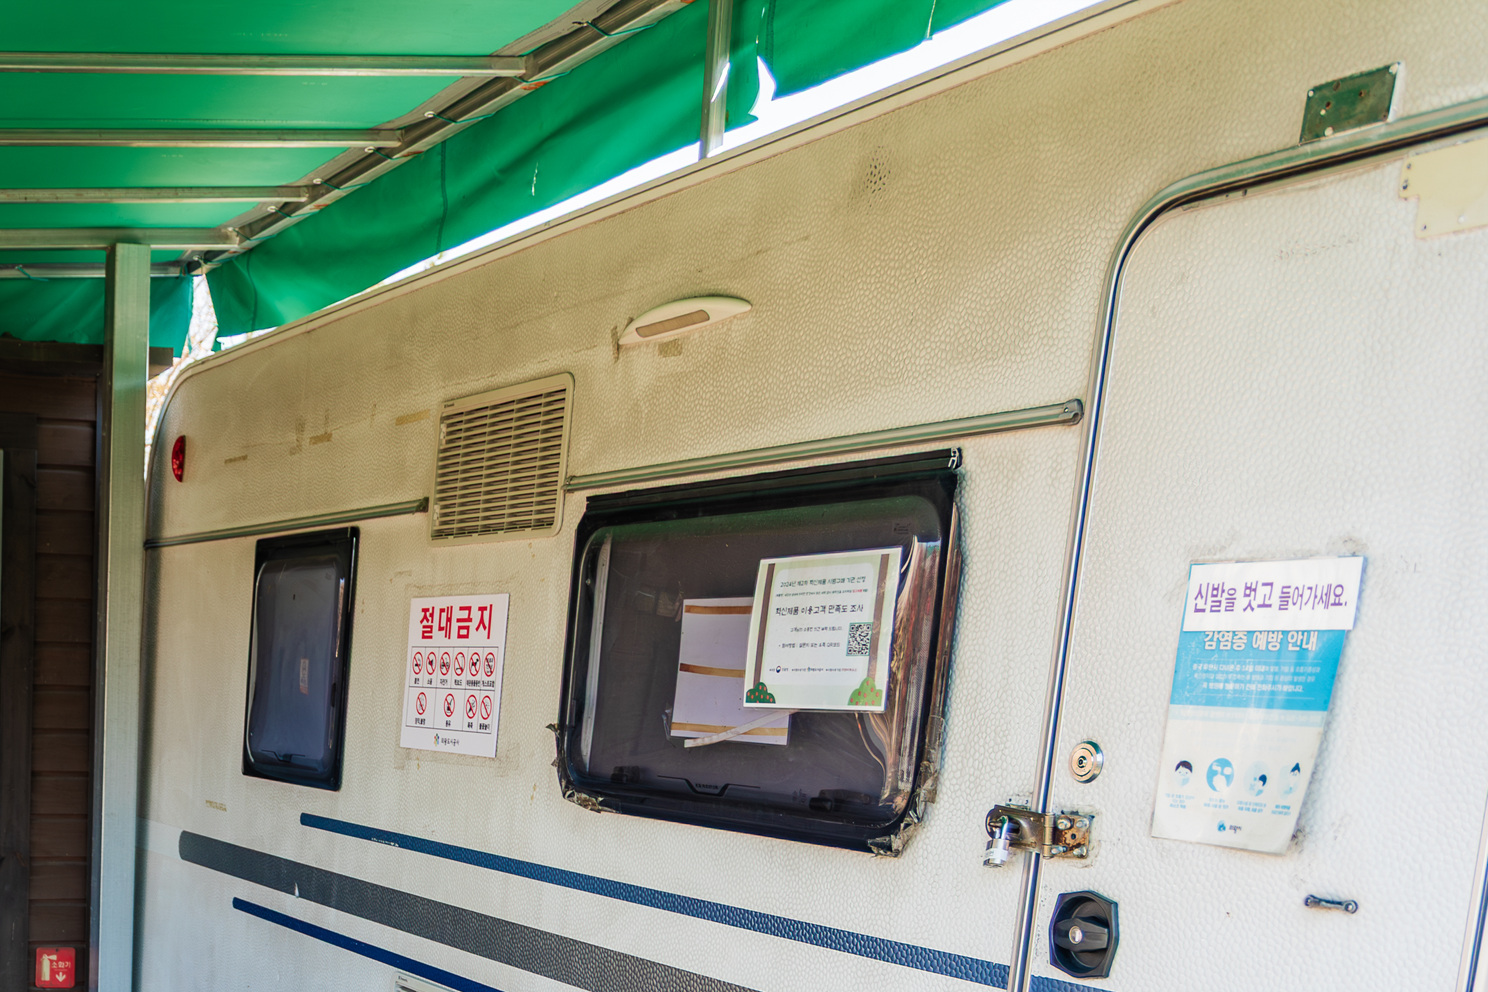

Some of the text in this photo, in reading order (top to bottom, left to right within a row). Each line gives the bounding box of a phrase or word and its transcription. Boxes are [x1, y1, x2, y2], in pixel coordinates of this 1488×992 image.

[1194, 580, 1348, 613] 신발을 벗고 들어가세요.
[420, 604, 494, 640] 절대금지
[776, 604, 864, 616] 혁신제품 이용고객 만족도 조사
[1204, 631, 1318, 651] 감염증 예방 안내
